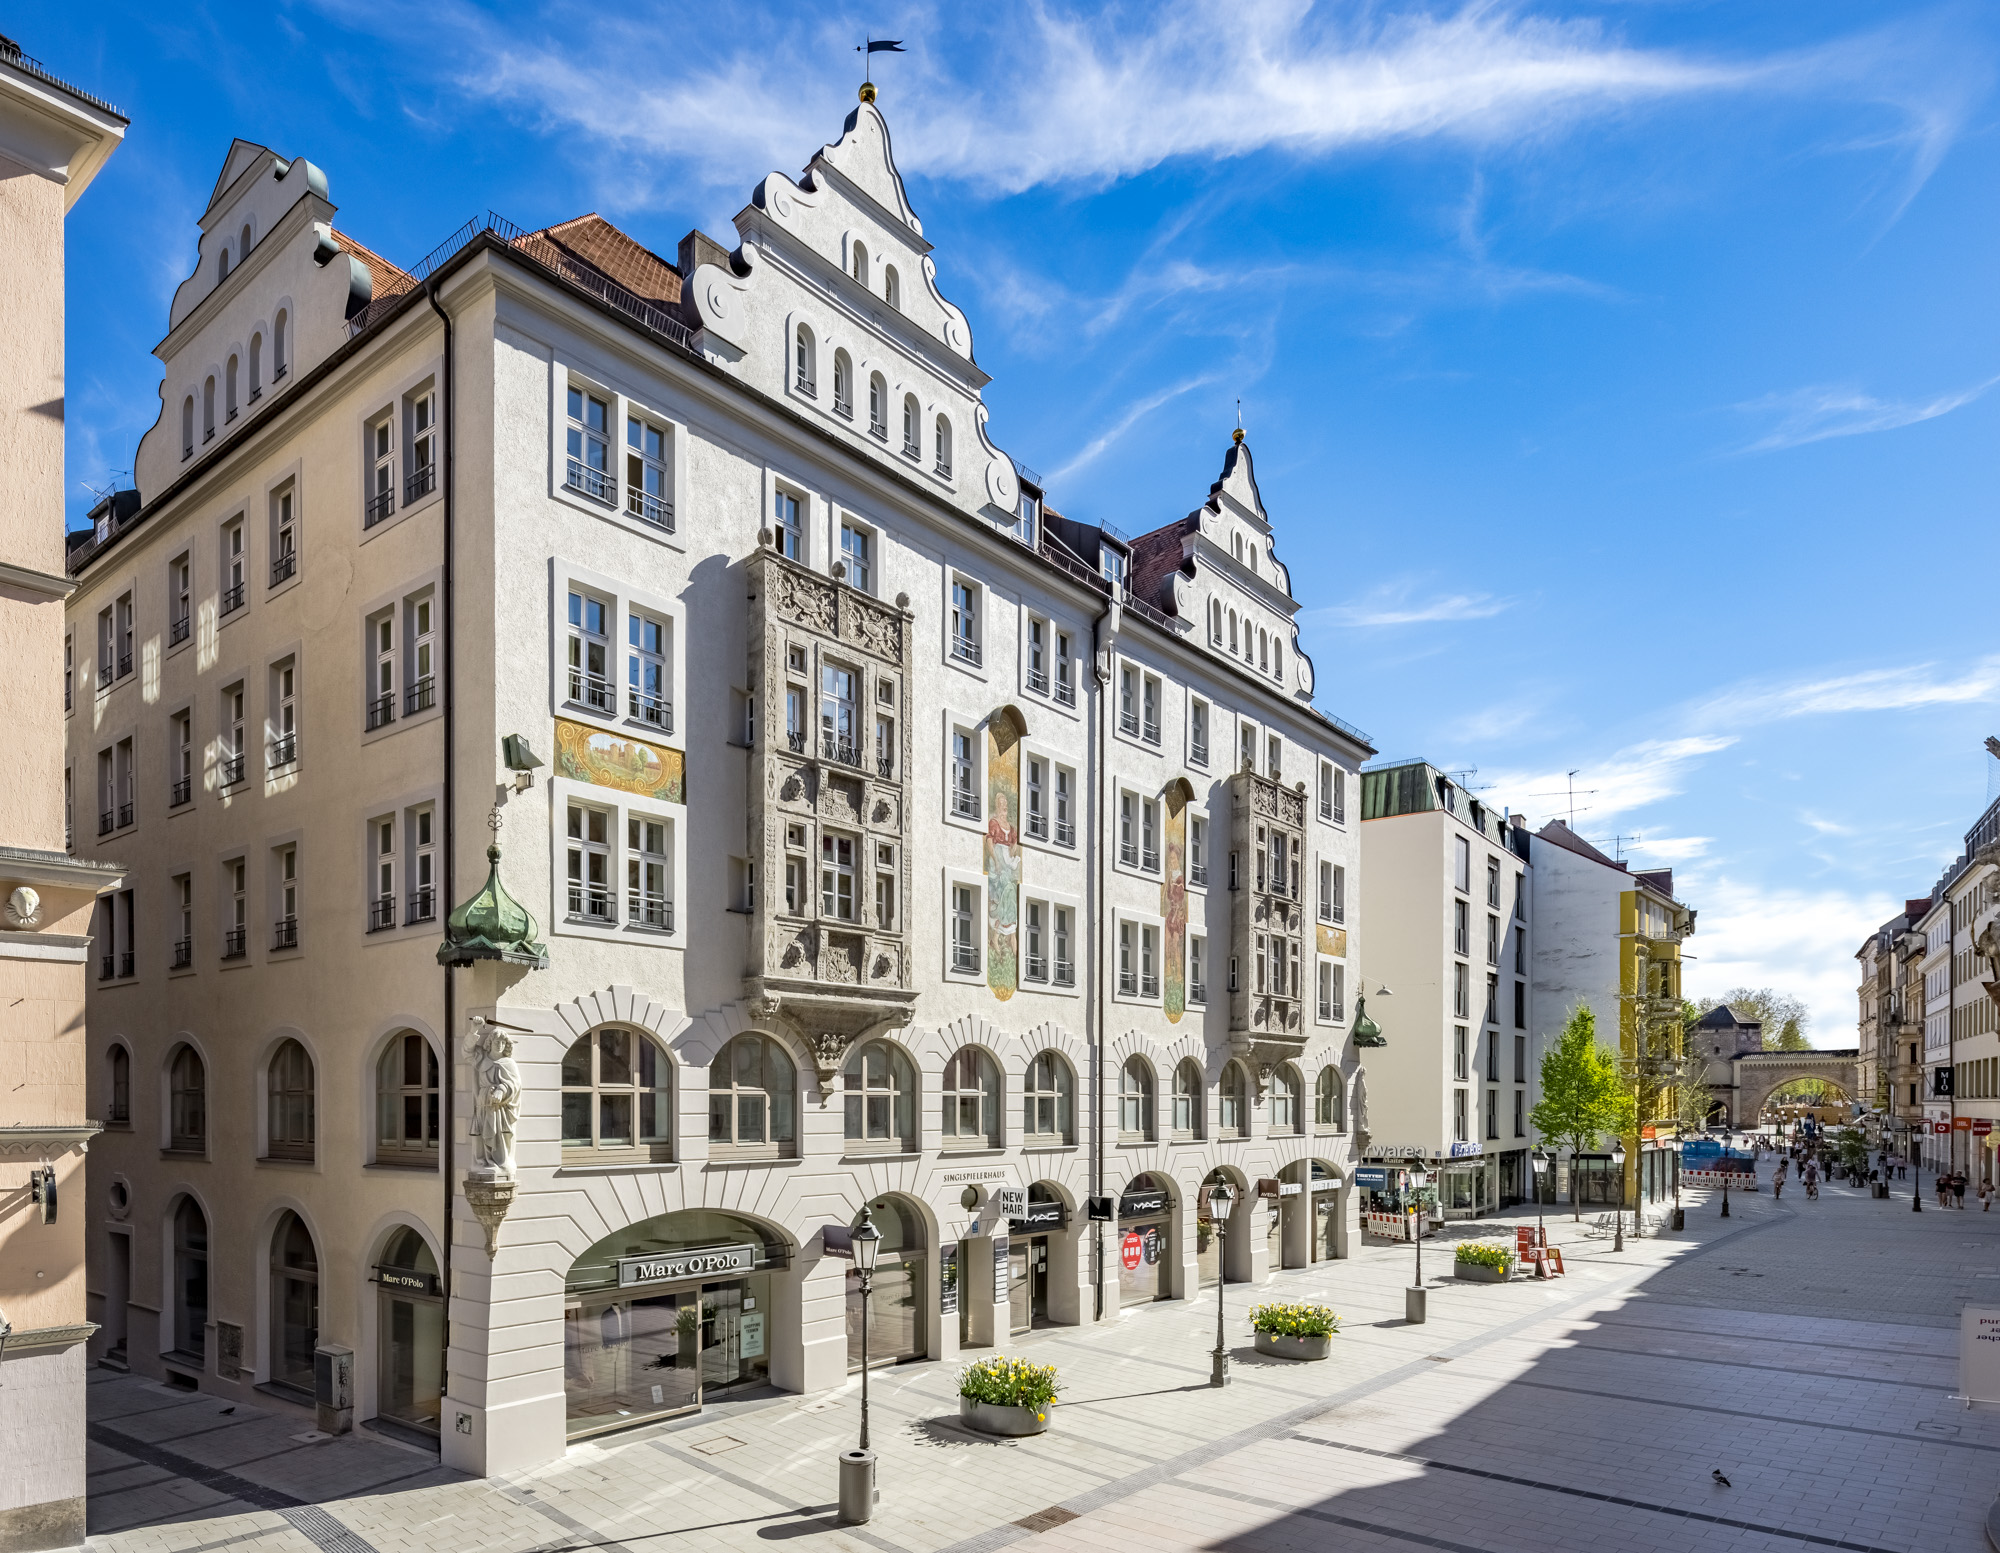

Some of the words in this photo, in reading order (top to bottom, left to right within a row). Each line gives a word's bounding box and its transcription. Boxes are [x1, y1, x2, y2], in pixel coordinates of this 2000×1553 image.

[1940, 1071, 1949, 1091] MIO
[943, 1170, 1006, 1183] SINGLSPIELERHAUS
[1002, 1191, 1024, 1203] NEW
[1002, 1203, 1024, 1215] HAIR
[1133, 1200, 1162, 1211] MAC
[1024, 1212, 1059, 1224] MAC
[638, 1262, 684, 1280] Marc
[688, 1254, 740, 1272] O'Polo
[383, 1273, 400, 1285] Marc
[401, 1276, 424, 1289] O'Polo
